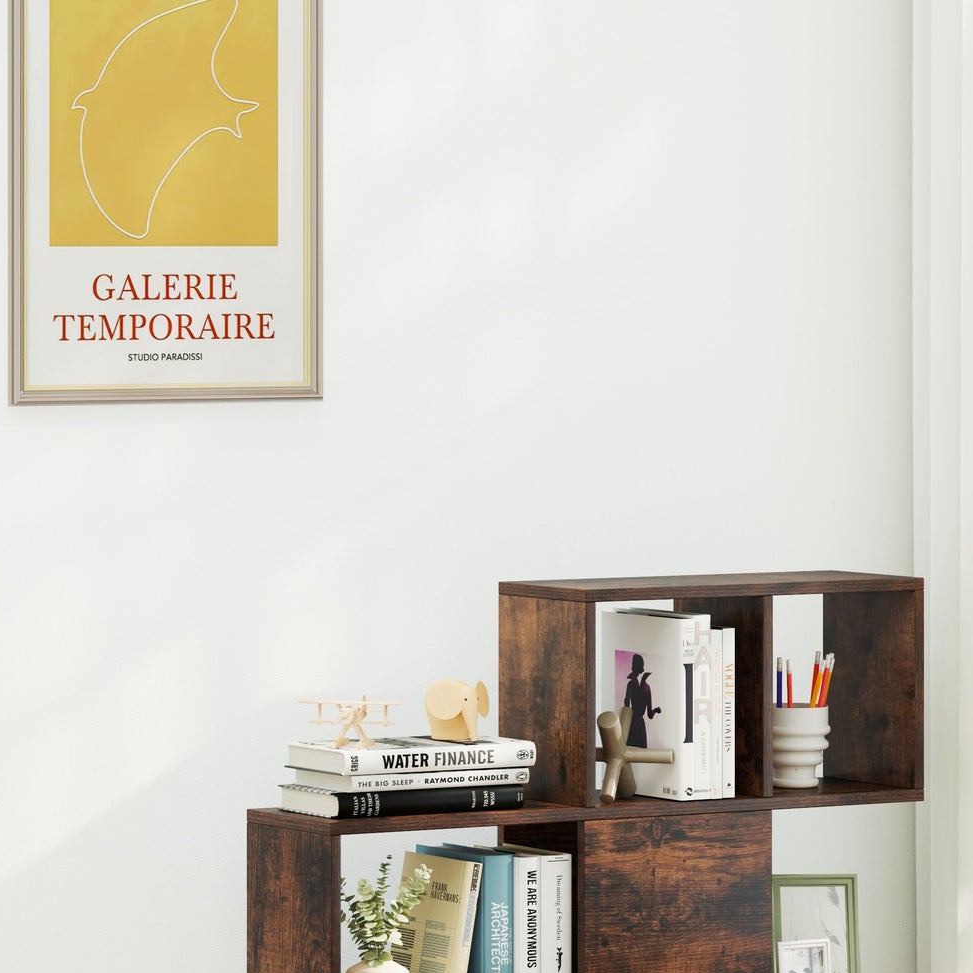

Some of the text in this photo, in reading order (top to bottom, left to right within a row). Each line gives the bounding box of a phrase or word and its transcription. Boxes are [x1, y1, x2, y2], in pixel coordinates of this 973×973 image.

[91, 273, 238, 301] GALERIE
[52, 313, 276, 342] TEMPORAIRE
[128, 352, 203, 362] STUDIO PARADISSI
[724, 663, 734, 699] VOGUE
[382, 750, 495, 769] WATER FINANCE
[392, 779, 414, 787] SLEEP
[424, 776, 465, 785] RAYMOND
[468, 773, 509, 782] CHANDLER
[431, 881, 449, 892] FRANK
[527, 870, 537, 885] WE
[527, 888, 537, 906] ARE
[555, 874, 563, 907] Dreaming
[556, 907, 563, 915] of
[501, 902, 509, 966] JAPANESE
[527, 909, 537, 968] ANONYMOUS
